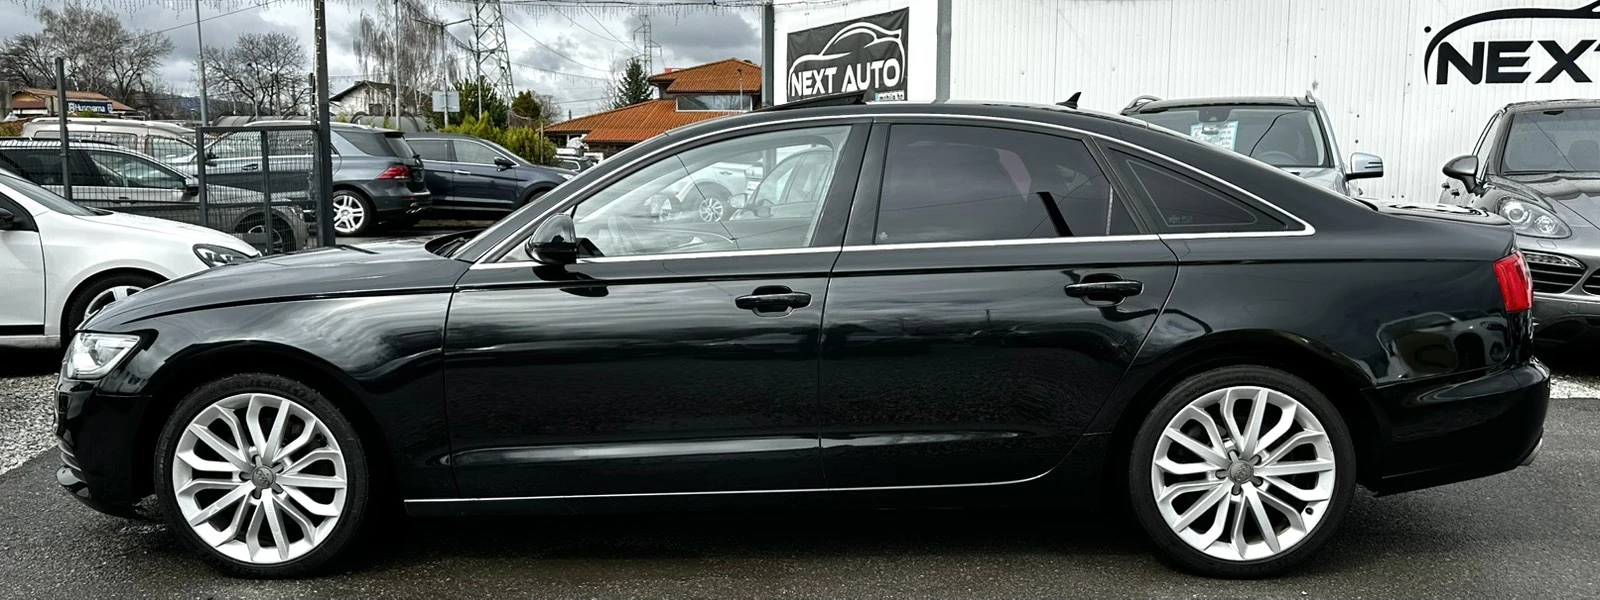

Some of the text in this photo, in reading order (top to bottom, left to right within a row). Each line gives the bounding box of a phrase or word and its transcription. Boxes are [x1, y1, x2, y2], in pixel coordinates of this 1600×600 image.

[791, 58, 901, 97] NEXT AUTO
[1436, 40, 1600, 85] NEX
